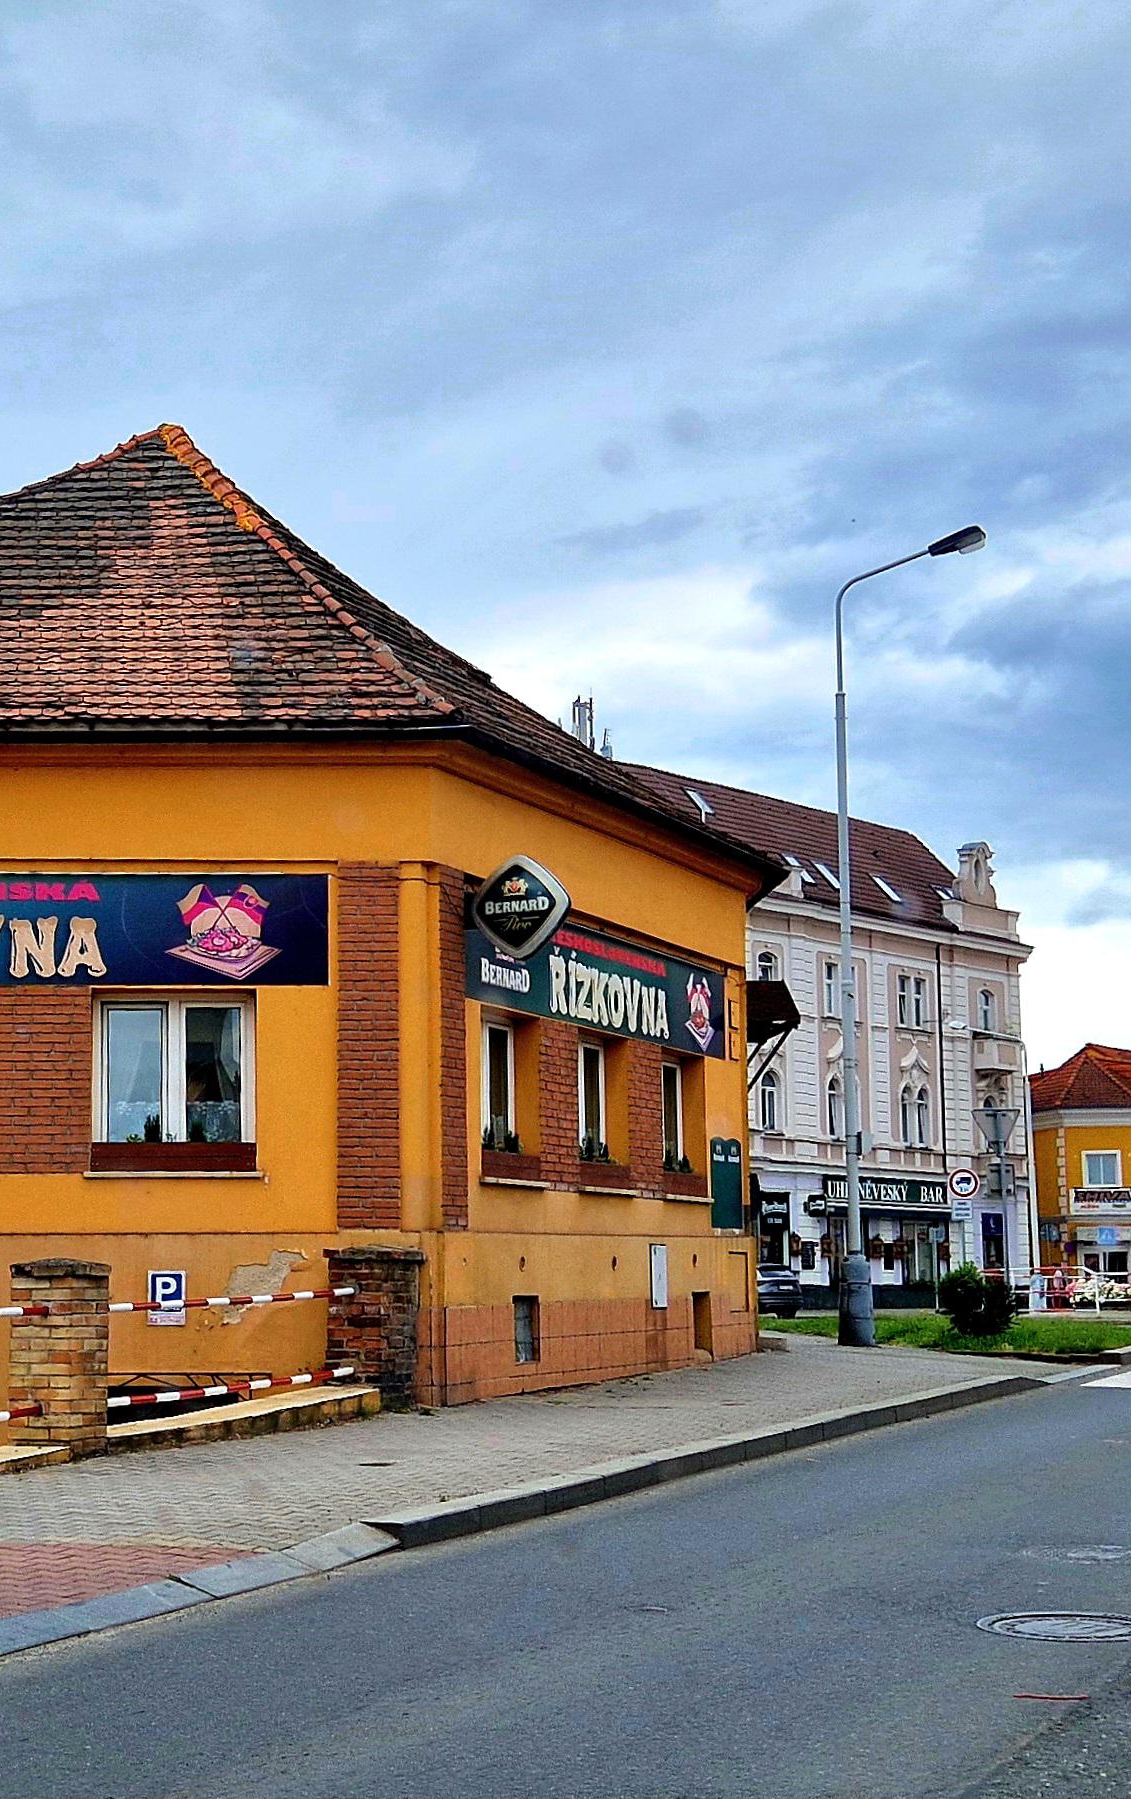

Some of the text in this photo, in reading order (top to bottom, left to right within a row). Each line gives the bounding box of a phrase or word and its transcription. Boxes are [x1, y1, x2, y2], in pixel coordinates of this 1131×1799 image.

[485, 896, 550, 915] BERNARD
[480, 956, 530, 993] BERNARD
[549, 945, 670, 1039] ŘÍZKOVNA
[827, 1180, 944, 1203] UHNĚVESKÝ BAR
[155, 1276, 177, 1303] P
